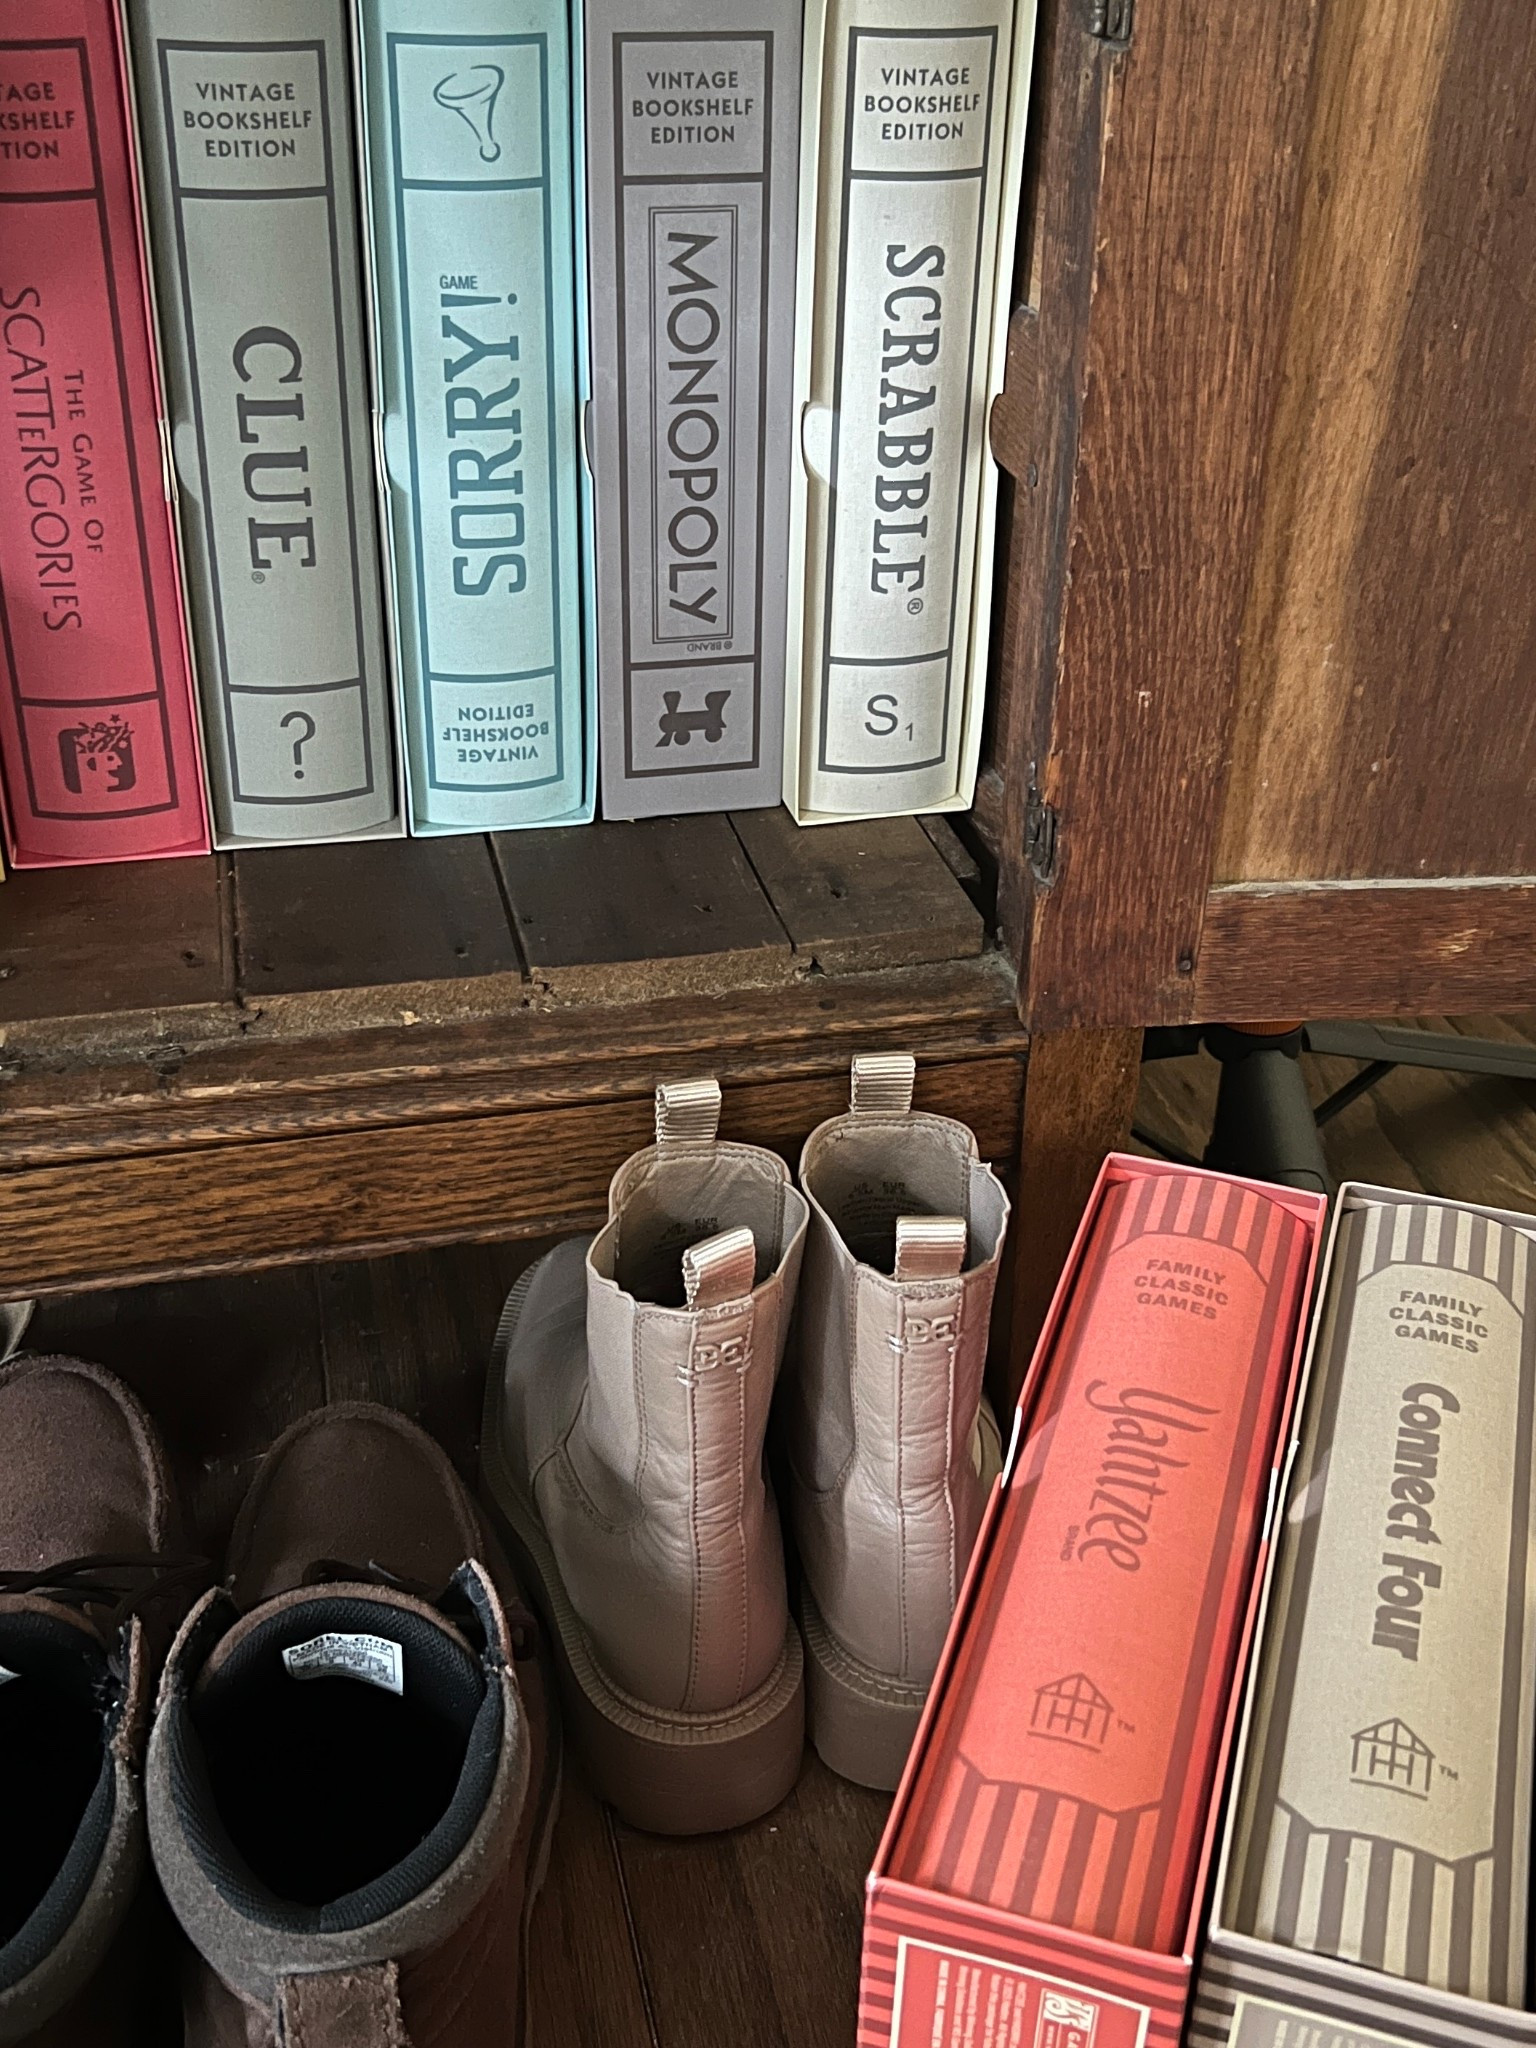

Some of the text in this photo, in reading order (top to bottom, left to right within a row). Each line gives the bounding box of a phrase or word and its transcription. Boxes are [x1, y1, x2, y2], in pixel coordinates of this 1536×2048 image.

[646, 71, 739, 90] VINTAGE
[880, 67, 971, 87] VINTAGE
[0, 82, 56, 101] AGE
[195, 82, 296, 101] VINTAGE
[632, 98, 754, 118] BOOKSHELF
[864, 93, 981, 114] BOOKSHELF
[183, 110, 313, 130] BOOKSHELF
[650, 125, 735, 145] EDITION
[881, 121, 964, 141] EDITION
[205, 139, 296, 158] EDITION
[439, 275, 478, 290] GAME
[666, 231, 721, 624] MONOPOLY
[440, 293, 527, 596] SORRY!
[0, 286, 83, 632] SCATTERGORIES
[64, 369, 104, 553] THE GAME OF
[686, 641, 722, 653] BRAND
[458, 703, 534, 721] EDITION
[442, 721, 549, 742] BOOKSHELF
[456, 745, 540, 763] VINTAGE
[1146, 1259, 1226, 1285] FAMILY
[1134, 1275, 1229, 1306] CLASSIC
[1137, 1293, 1217, 1320] GAMES
[1399, 1290, 1483, 1318] FAMILY
[1389, 1307, 1489, 1338] CLASSIC
[1395, 1324, 1479, 1353] GAMES
[1077, 1379, 1222, 1573] Yahtzee
[1372, 1382, 1461, 1662] Connect Four
